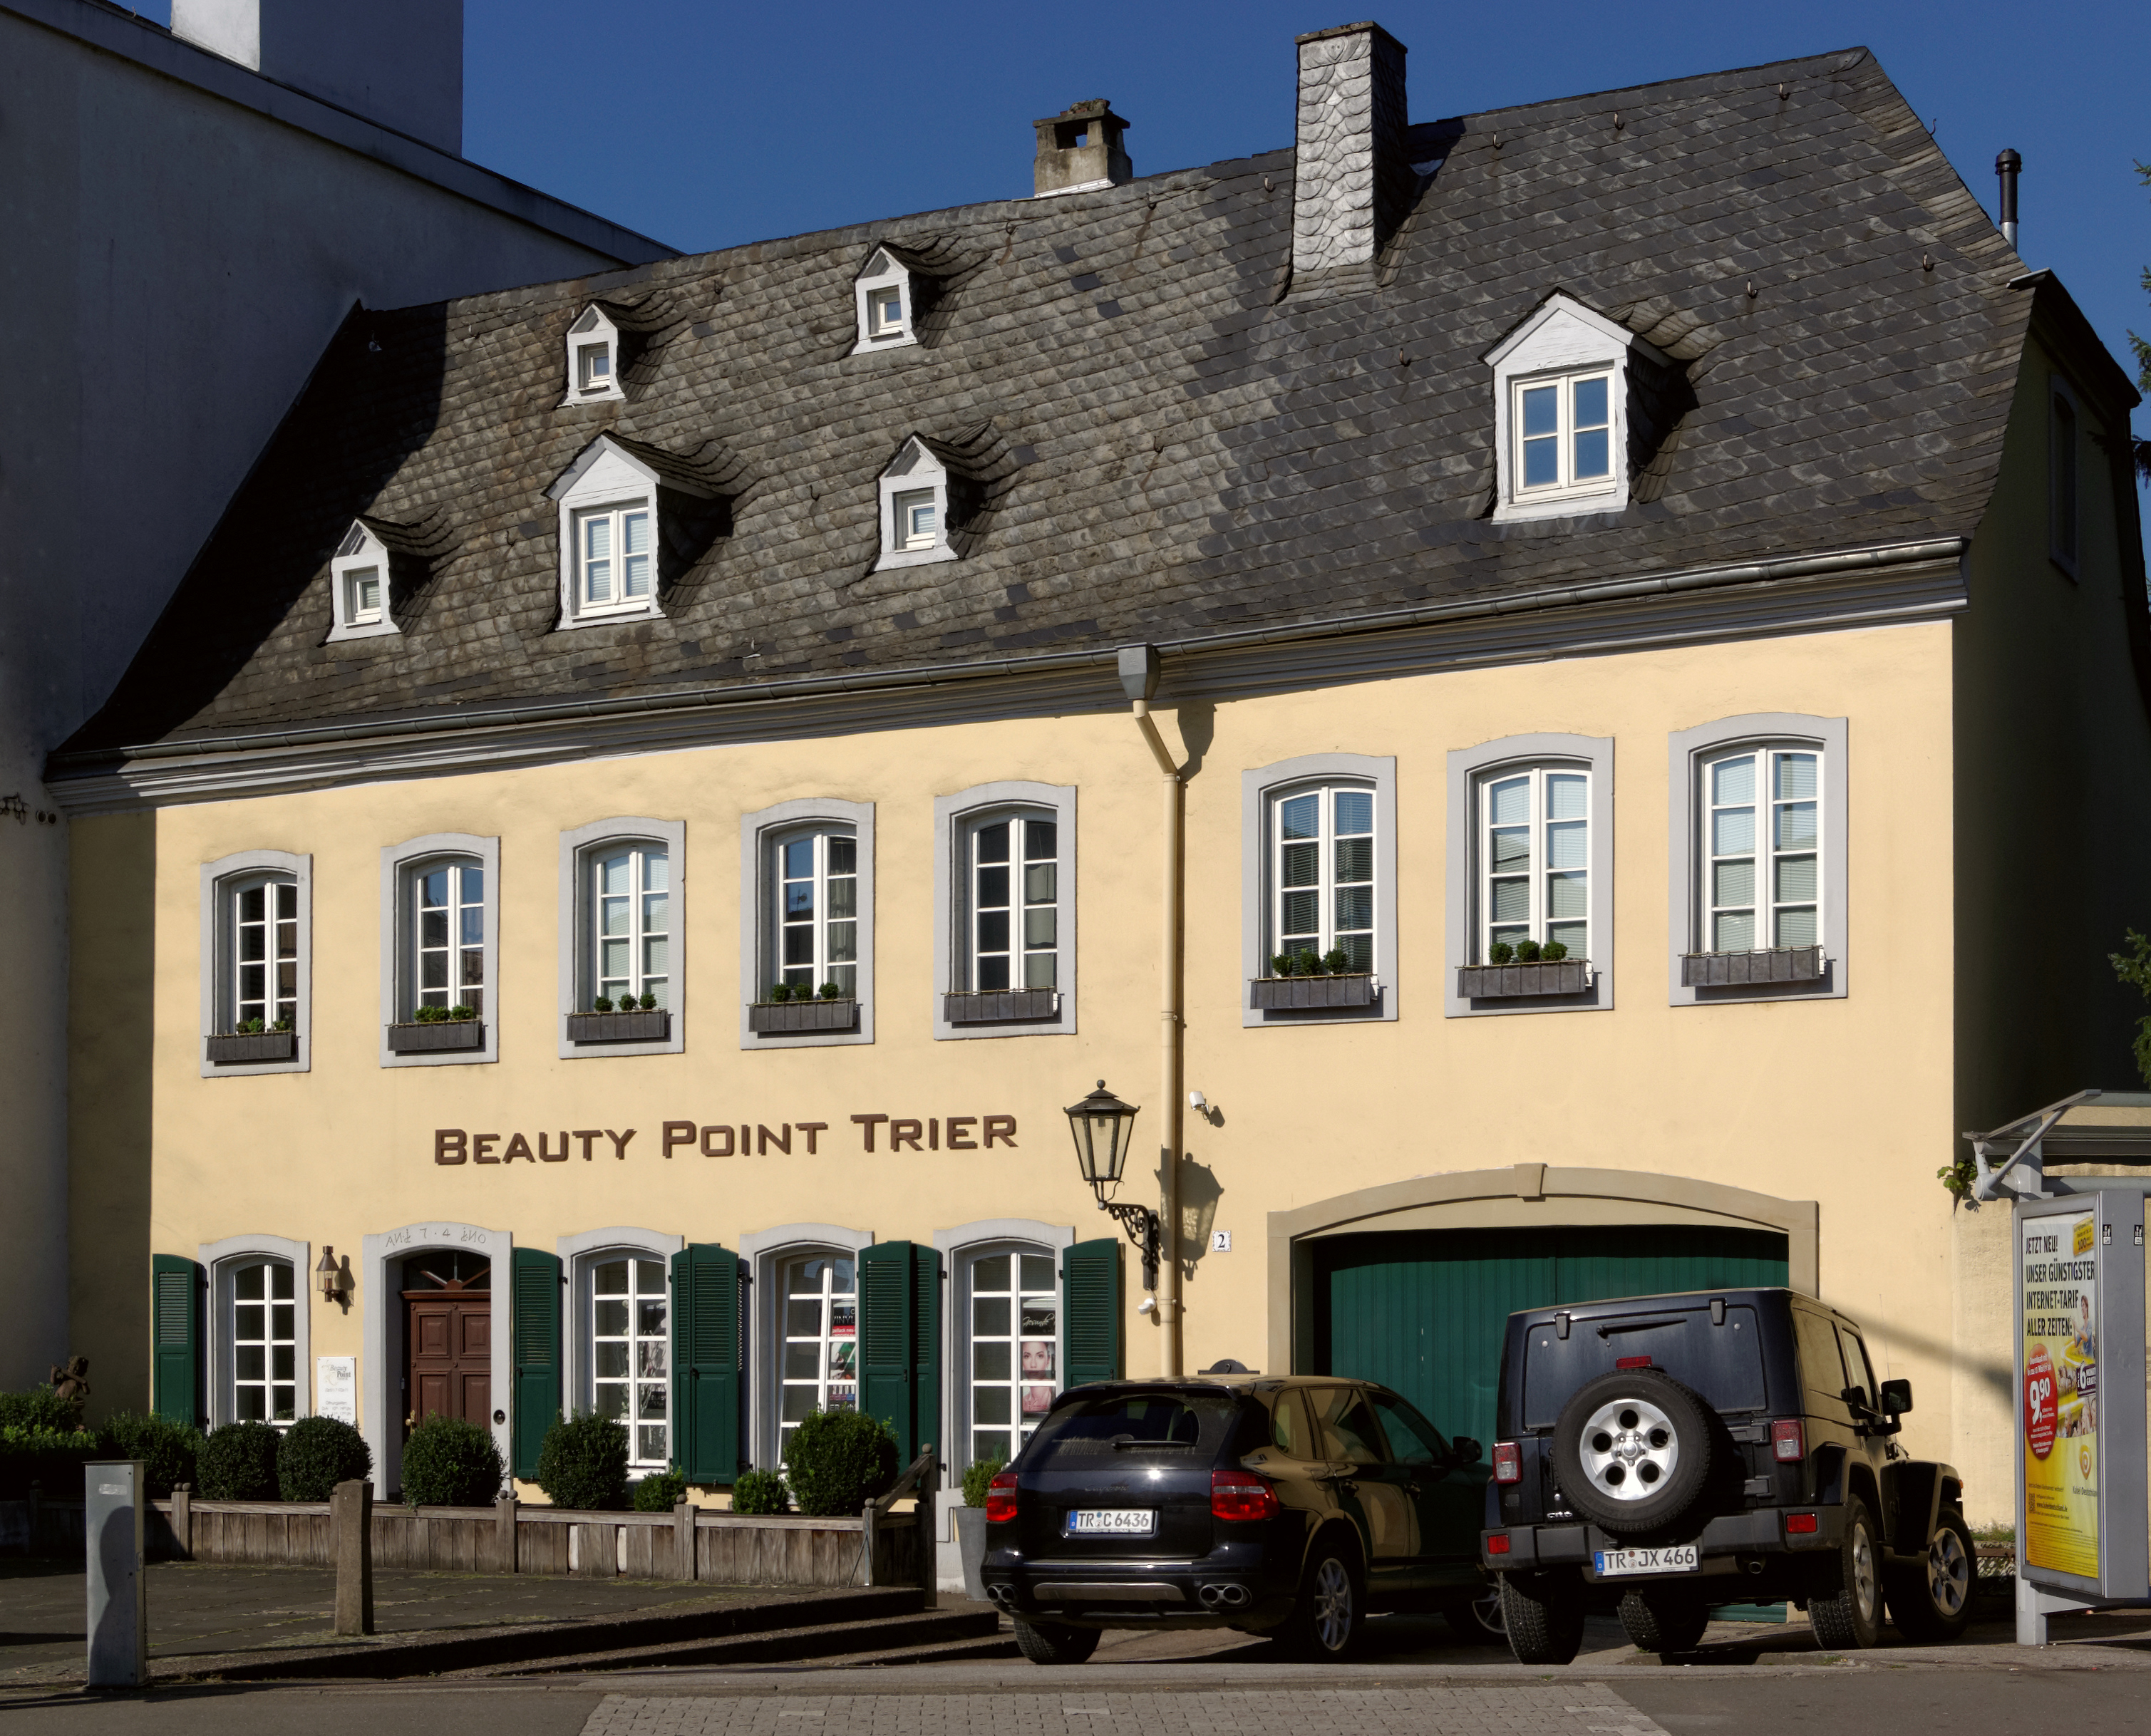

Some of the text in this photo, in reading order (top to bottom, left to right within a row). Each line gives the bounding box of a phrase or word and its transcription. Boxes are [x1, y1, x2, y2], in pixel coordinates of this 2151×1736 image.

[1218, 1234, 1226, 1248] 2
[2026, 1234, 2058, 1254] JETZT NEU!
[2026, 1257, 2095, 1283] UNSER GÜNSTIGSTER
[2026, 1289, 2079, 1310] INTERNET-TARIF
[2026, 1317, 2073, 1337] ALLER ZEITEN:
[2080, 1362, 2087, 1390] 6
[1078, 1513, 1095, 1527] TR
[1103, 1513, 1112, 1526] C
[1115, 1512, 1150, 1527] 6436
[1605, 1552, 1626, 1569] TR
[1638, 1550, 1660, 1567] JX
[1663, 1548, 1695, 1566] 466
